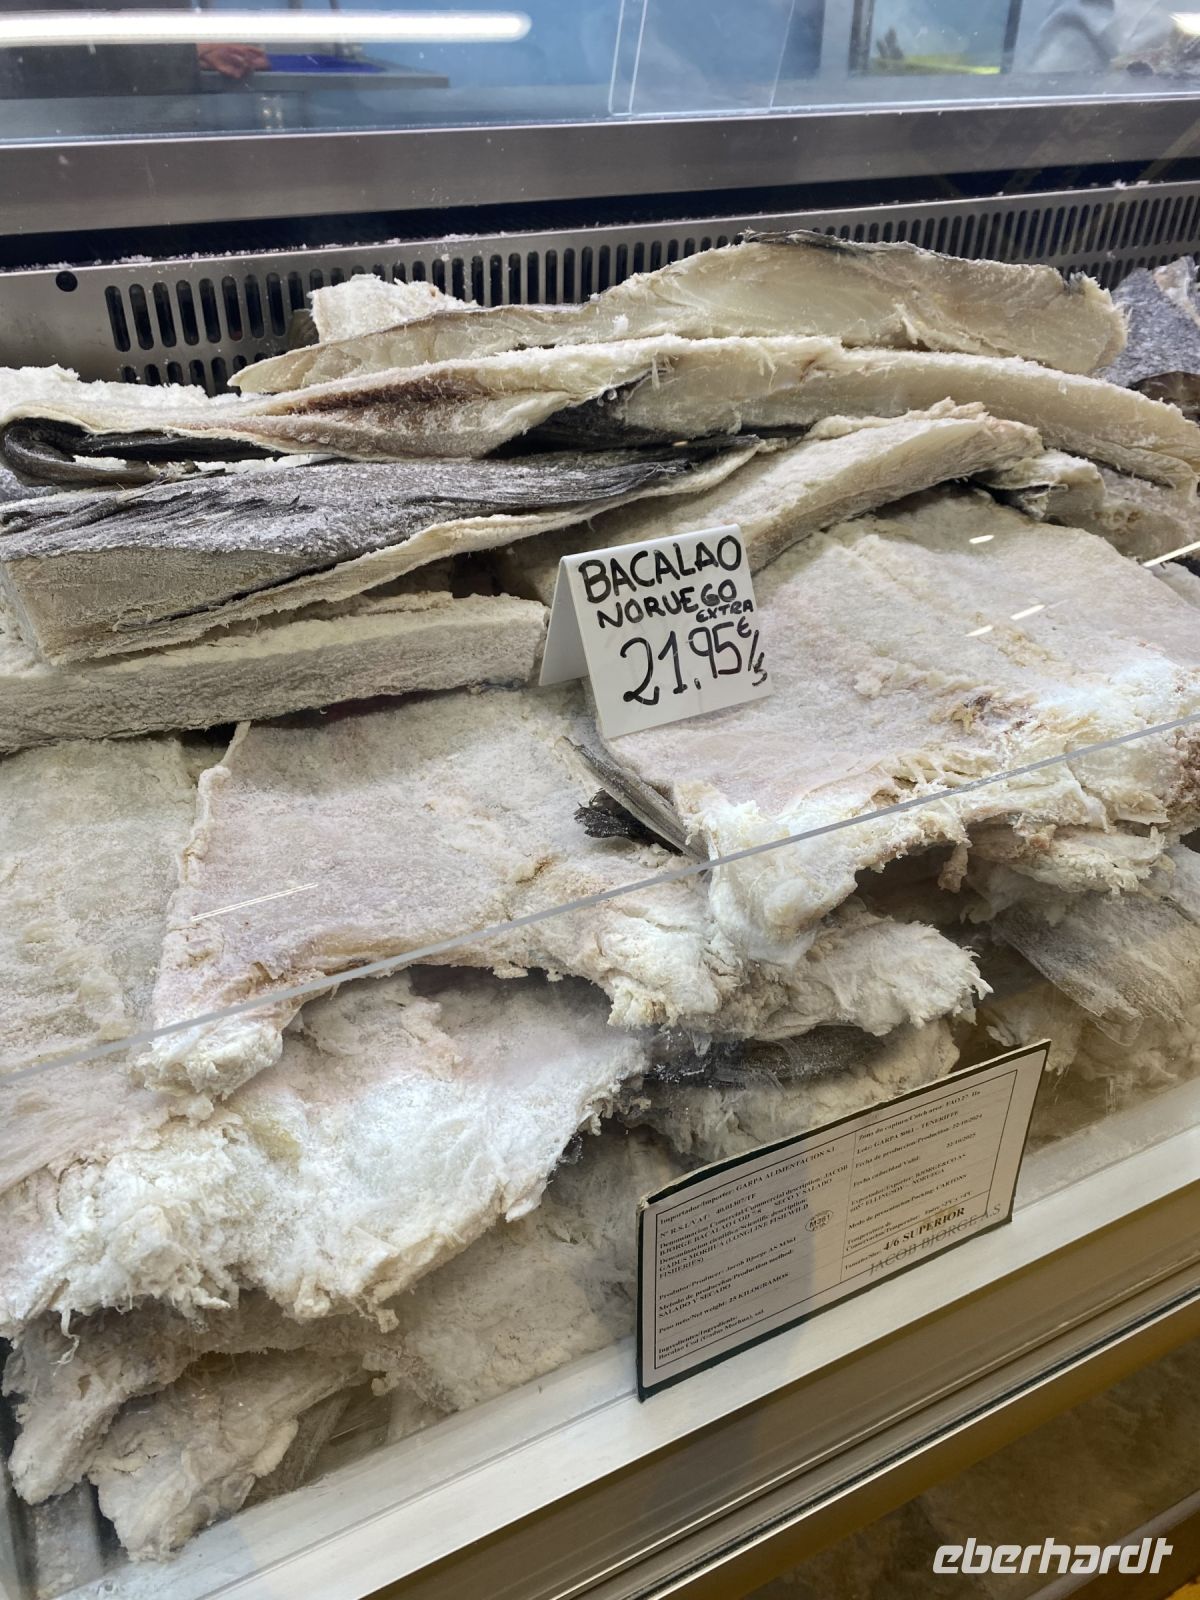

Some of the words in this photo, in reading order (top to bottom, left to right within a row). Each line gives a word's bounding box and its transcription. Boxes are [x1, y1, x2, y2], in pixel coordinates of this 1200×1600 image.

[578, 535, 742, 603] BACALAO
[597, 579, 737, 628] NORUEGO
[696, 599, 753, 623] EXTRA
[902, 1205, 966, 1243] SUPERIOR
